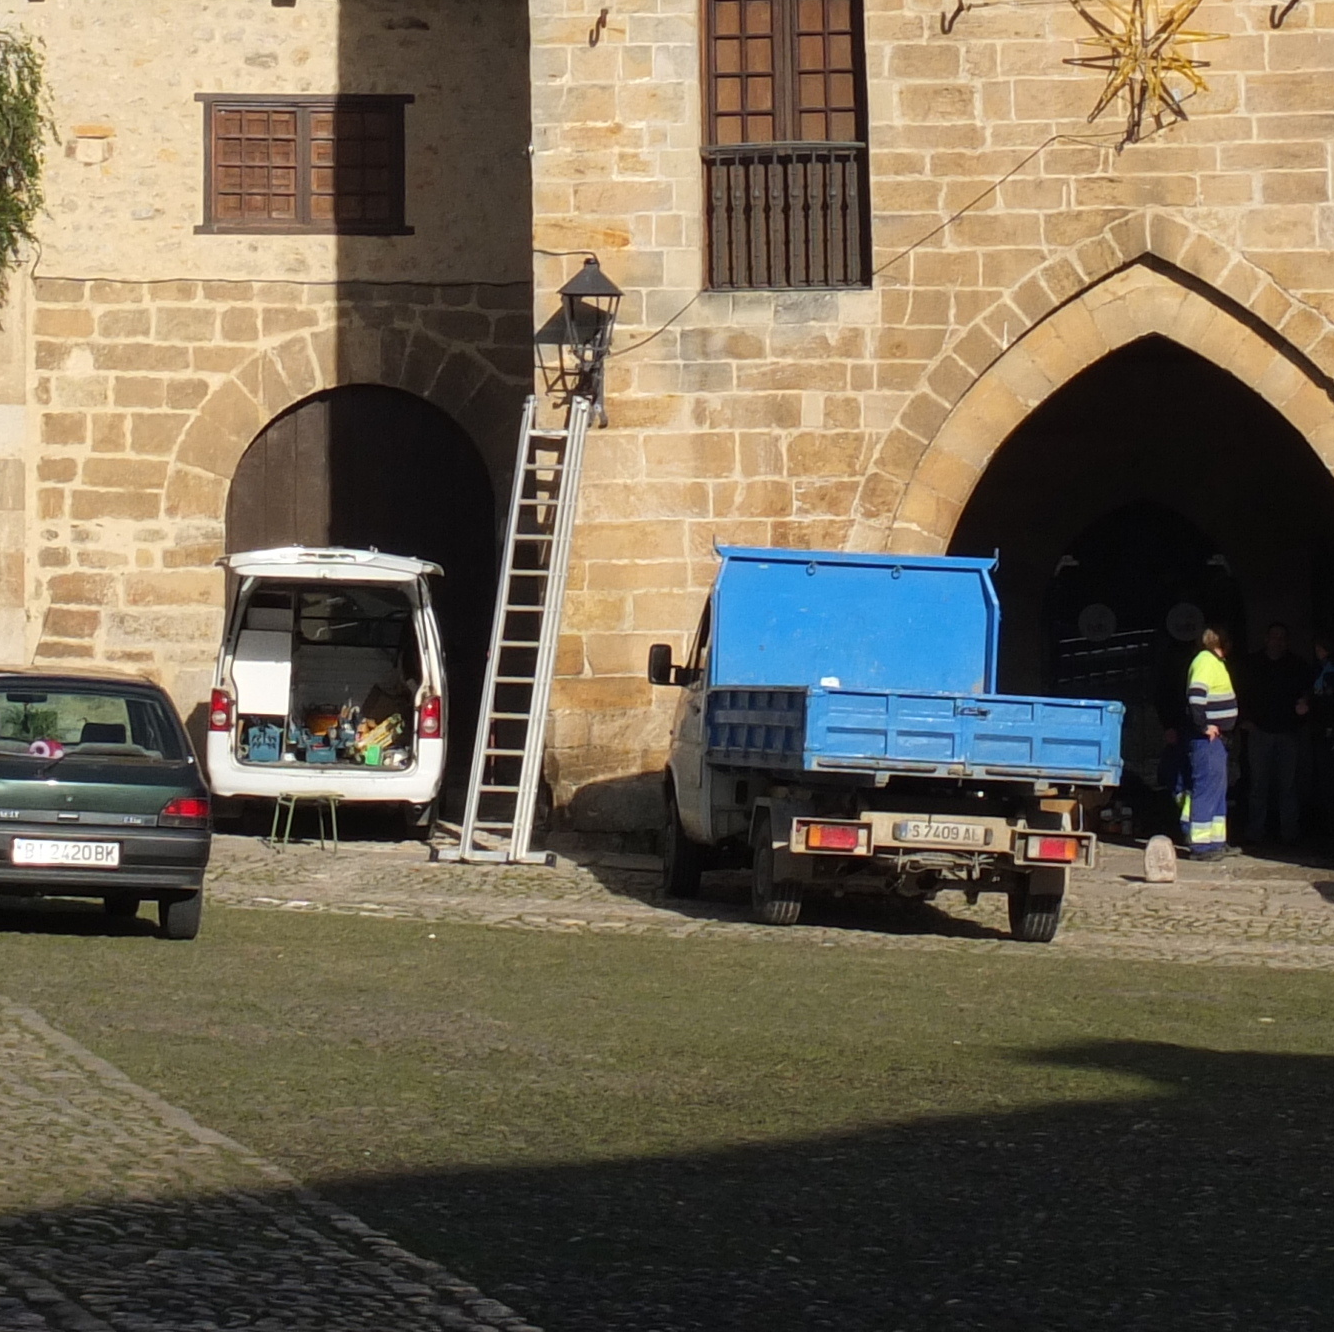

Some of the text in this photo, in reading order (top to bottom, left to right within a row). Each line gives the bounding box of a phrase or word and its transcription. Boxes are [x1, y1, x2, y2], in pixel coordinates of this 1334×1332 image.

[923, 825, 959, 840] 7409
[50, 843, 92, 861] 2420
[94, 845, 116, 863] BK
